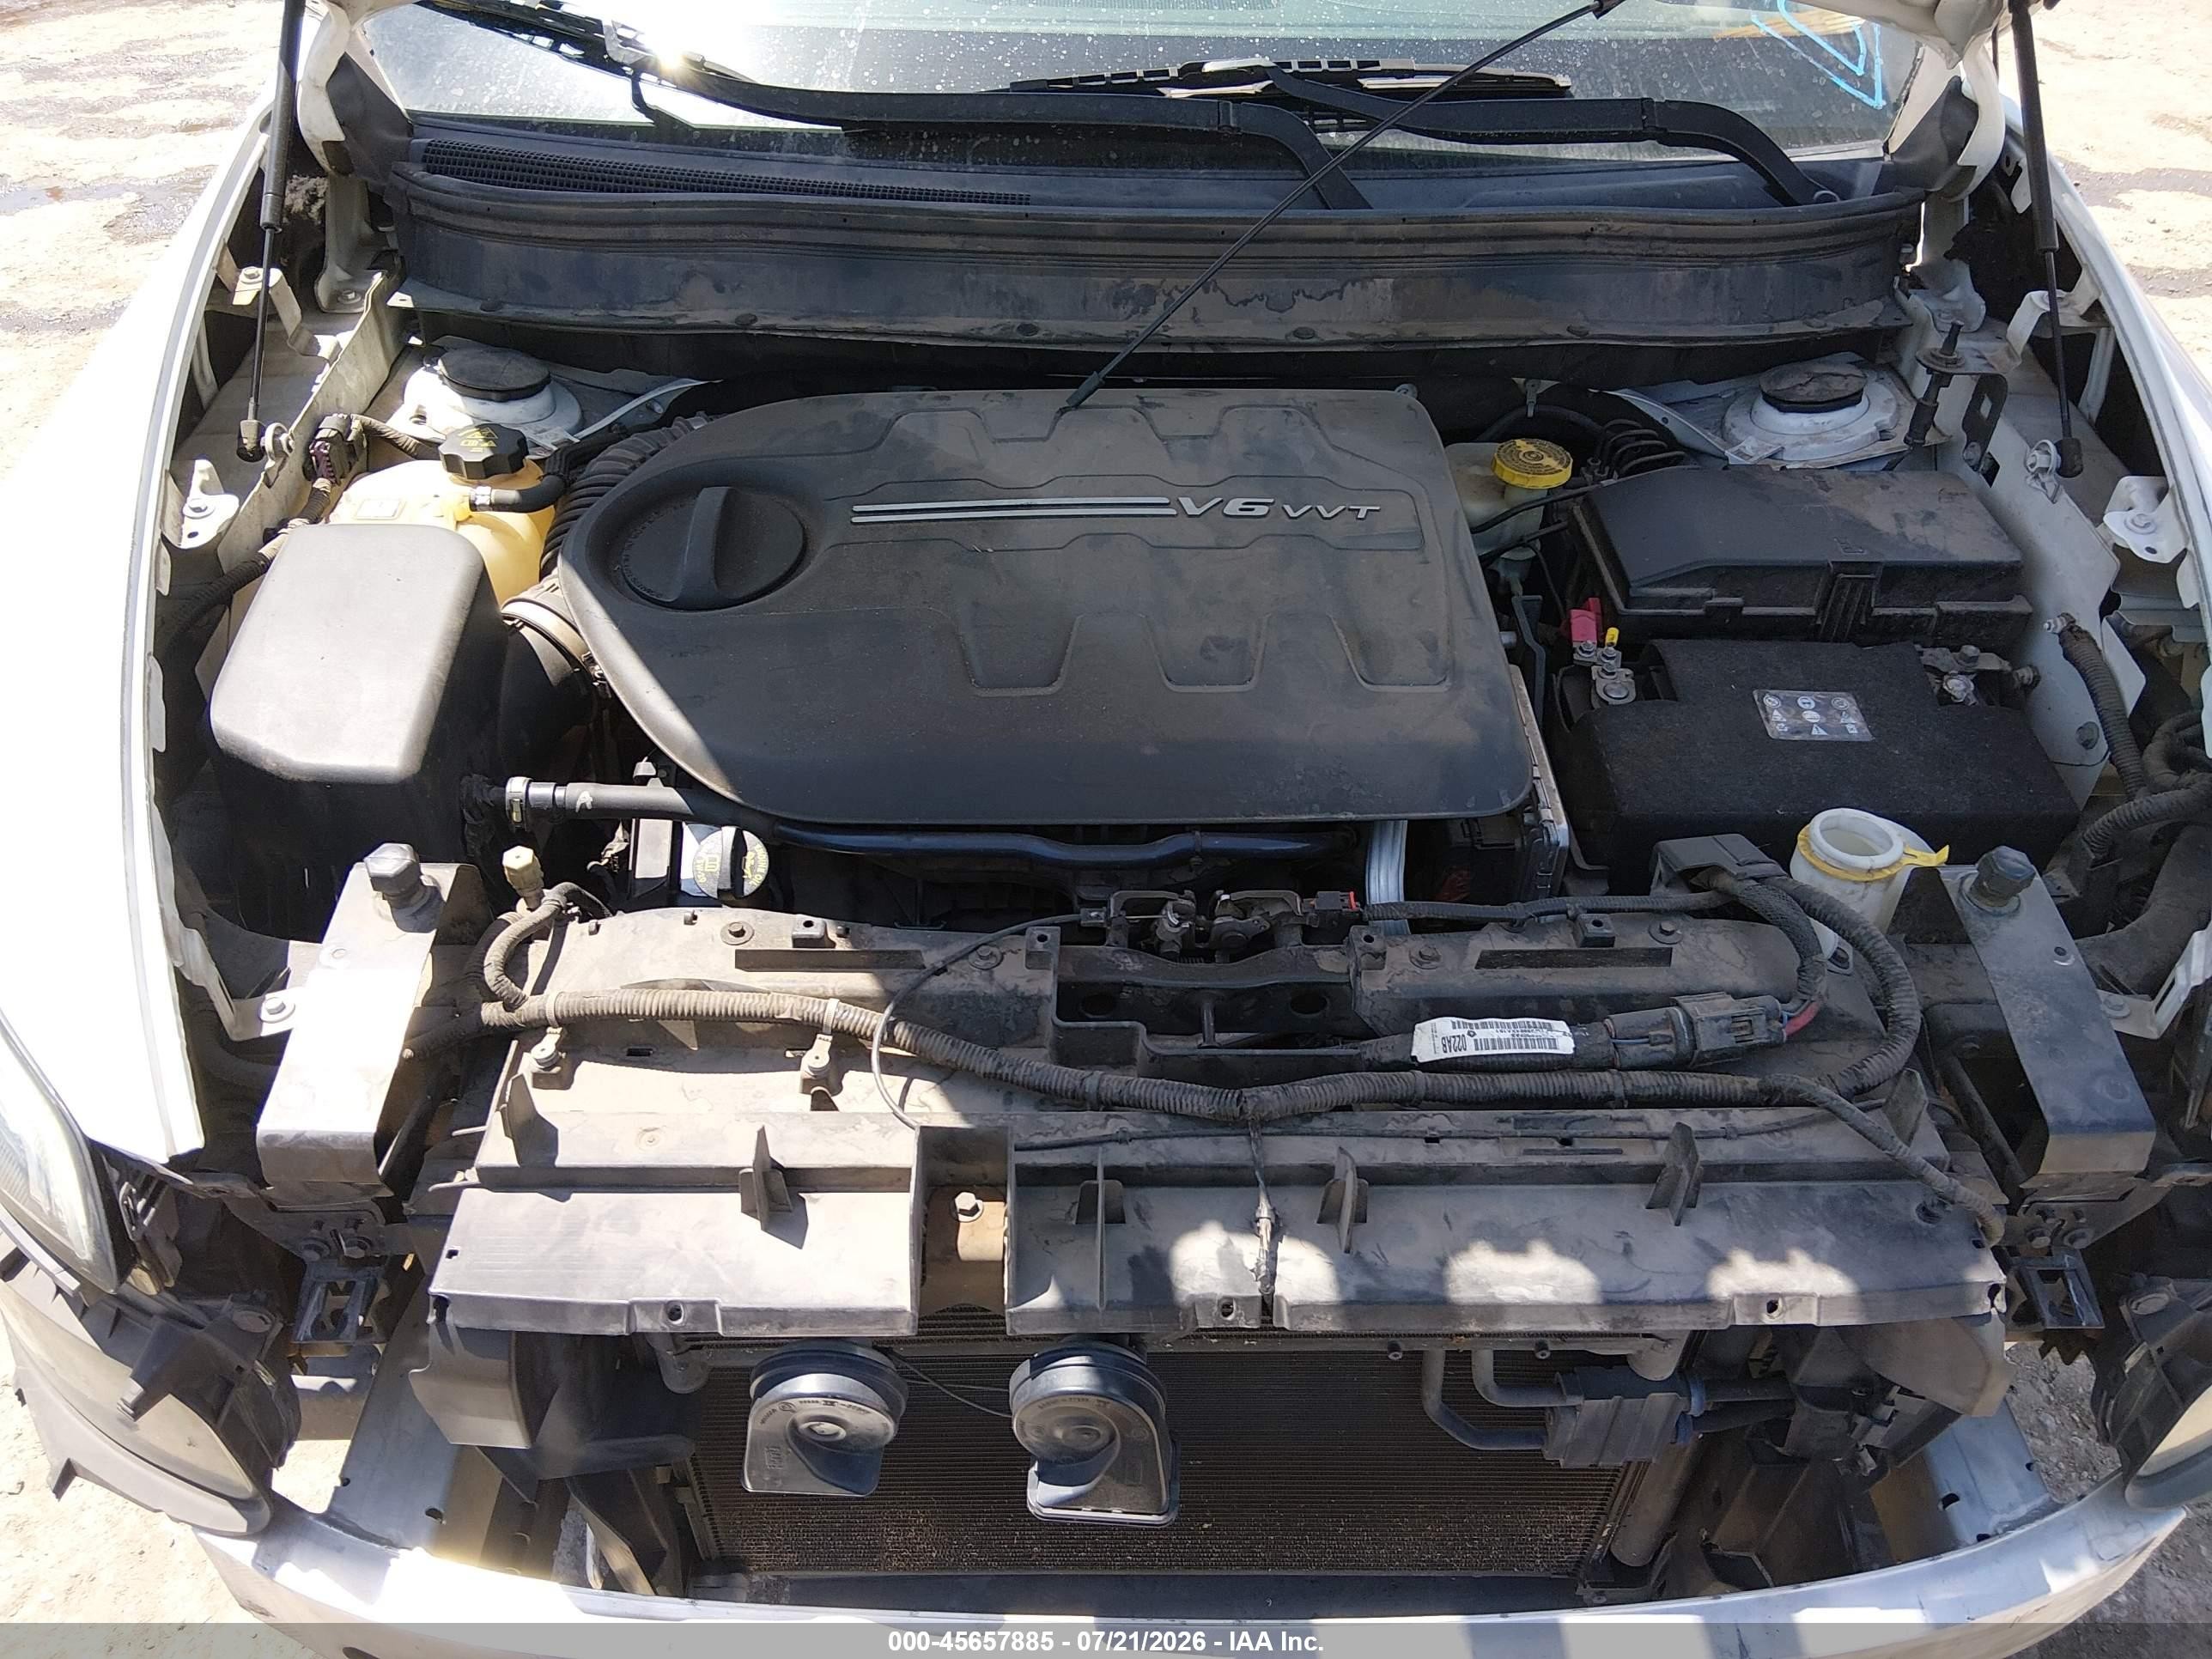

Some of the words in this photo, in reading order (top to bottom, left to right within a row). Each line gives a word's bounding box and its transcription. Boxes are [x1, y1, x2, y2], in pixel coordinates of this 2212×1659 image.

[1178, 497, 1275, 516] V6
[1283, 505, 1381, 520] VVT
[754, 843, 769, 873] ENGINE
[749, 874, 763, 887] OIL
[1442, 1034, 1467, 1054] 022AB
